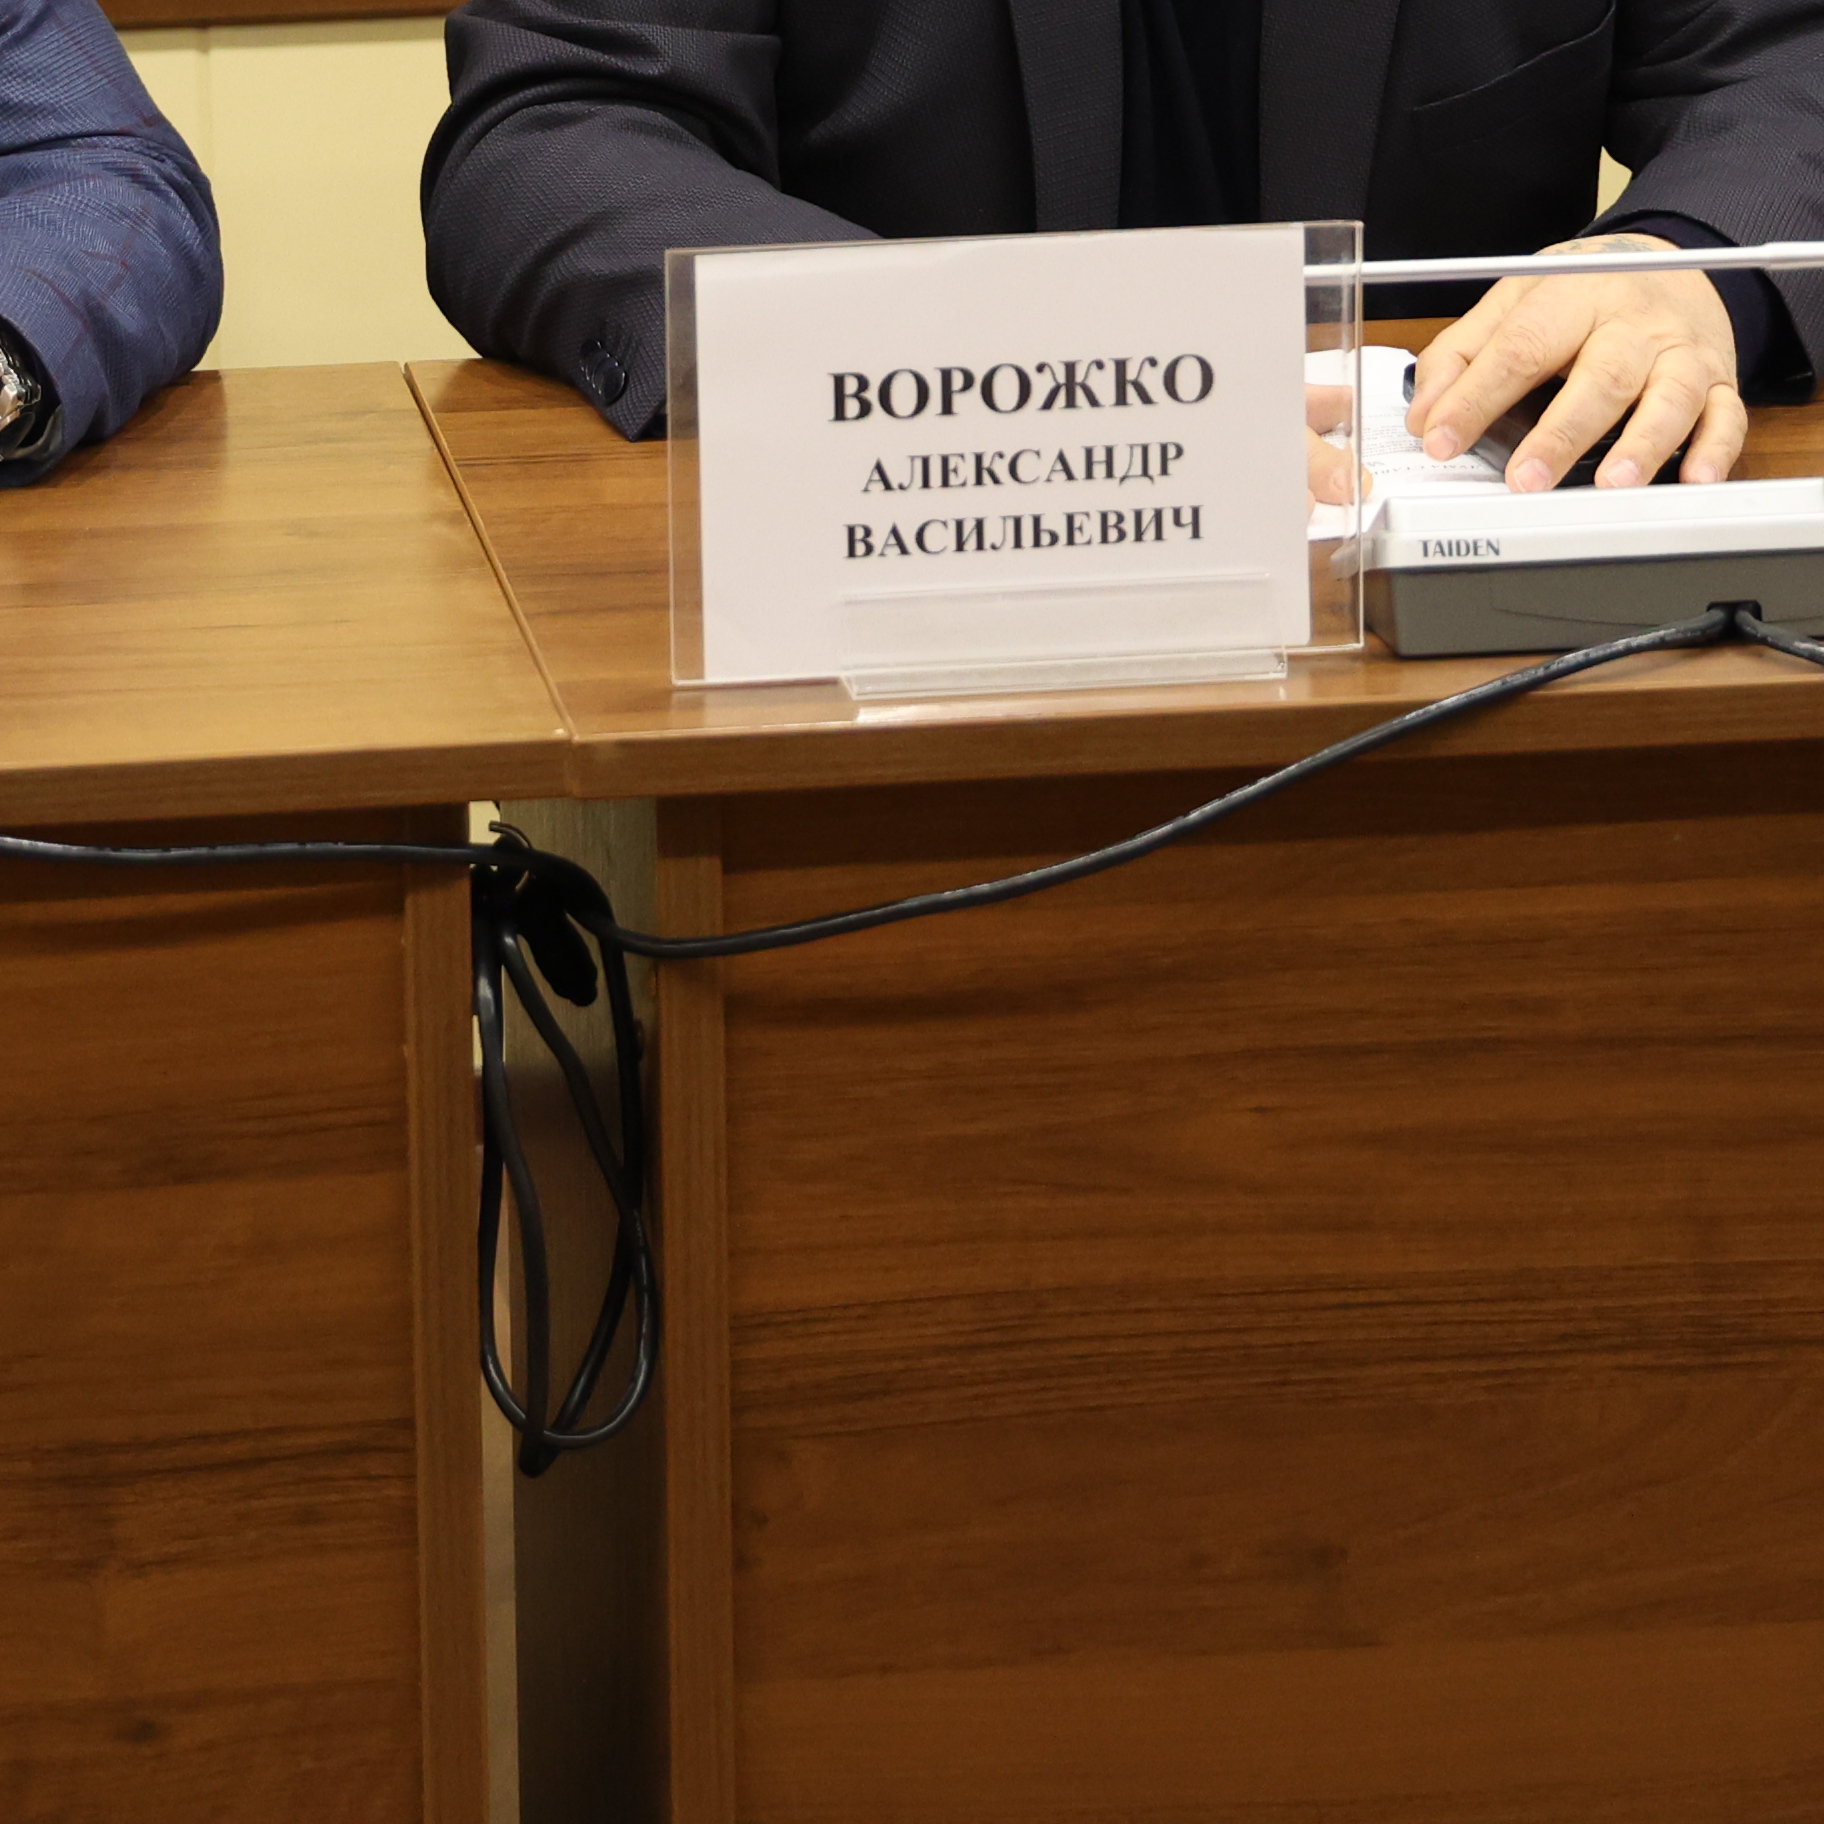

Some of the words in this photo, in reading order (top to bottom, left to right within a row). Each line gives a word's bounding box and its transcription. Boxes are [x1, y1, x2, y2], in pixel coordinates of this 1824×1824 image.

[829, 353, 1215, 424] ВОРОЖКО
[862, 441, 1185, 494] АЛЕКСАНДР
[844, 504, 1203, 560] ВАСИЛЬЕВИЧ
[1420, 537, 1502, 559] TAIDEN
